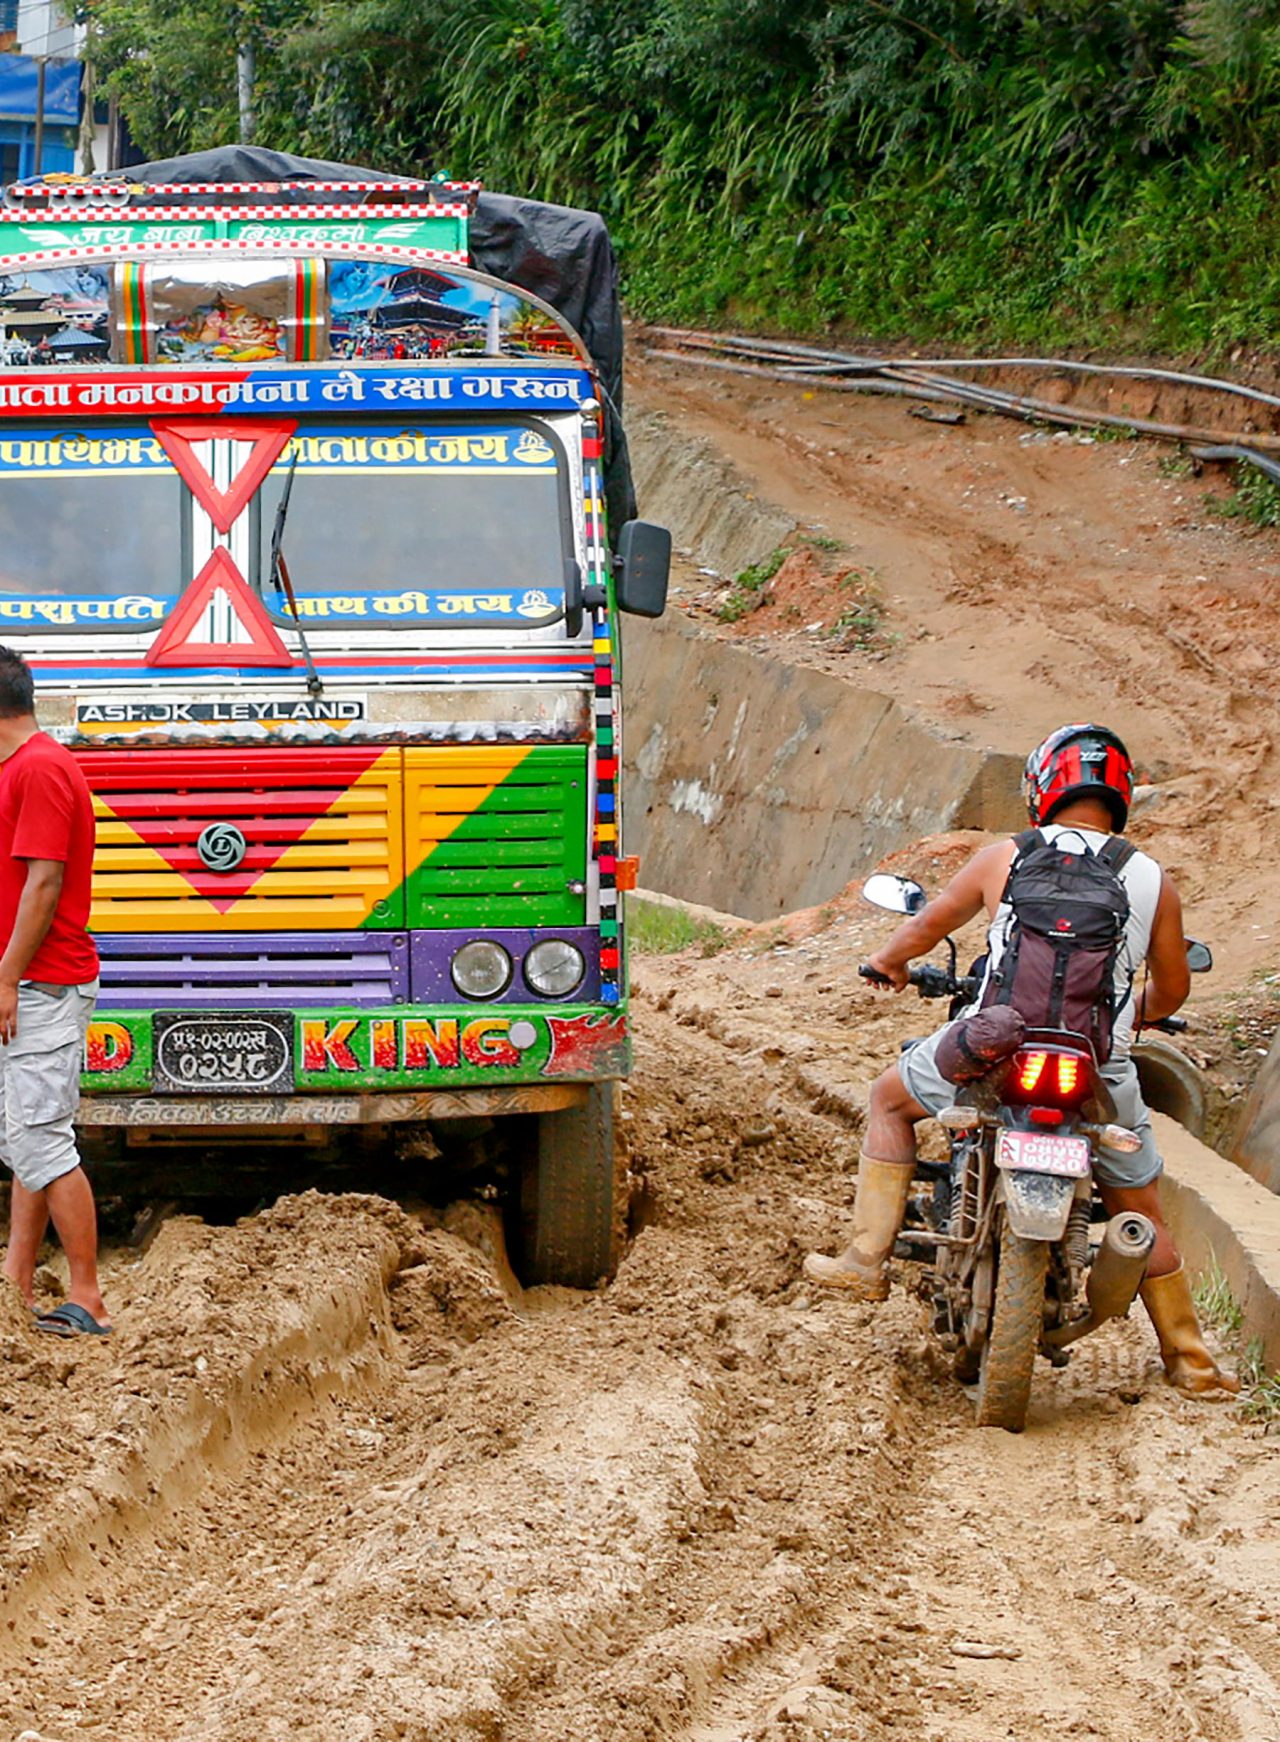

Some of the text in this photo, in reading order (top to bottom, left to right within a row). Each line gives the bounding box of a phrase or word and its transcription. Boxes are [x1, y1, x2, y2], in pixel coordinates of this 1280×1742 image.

[71, 226, 134, 246] जय
[143, 225, 205, 242] बाबा
[77, 379, 310, 406] मनकामना
[321, 370, 365, 401] ले
[372, 377, 454, 400] रक्षा
[372, 591, 430, 615] की
[436, 594, 514, 614] जय
[212, 702, 360, 720] LEYLAND
[300, 1018, 522, 1073] KING
